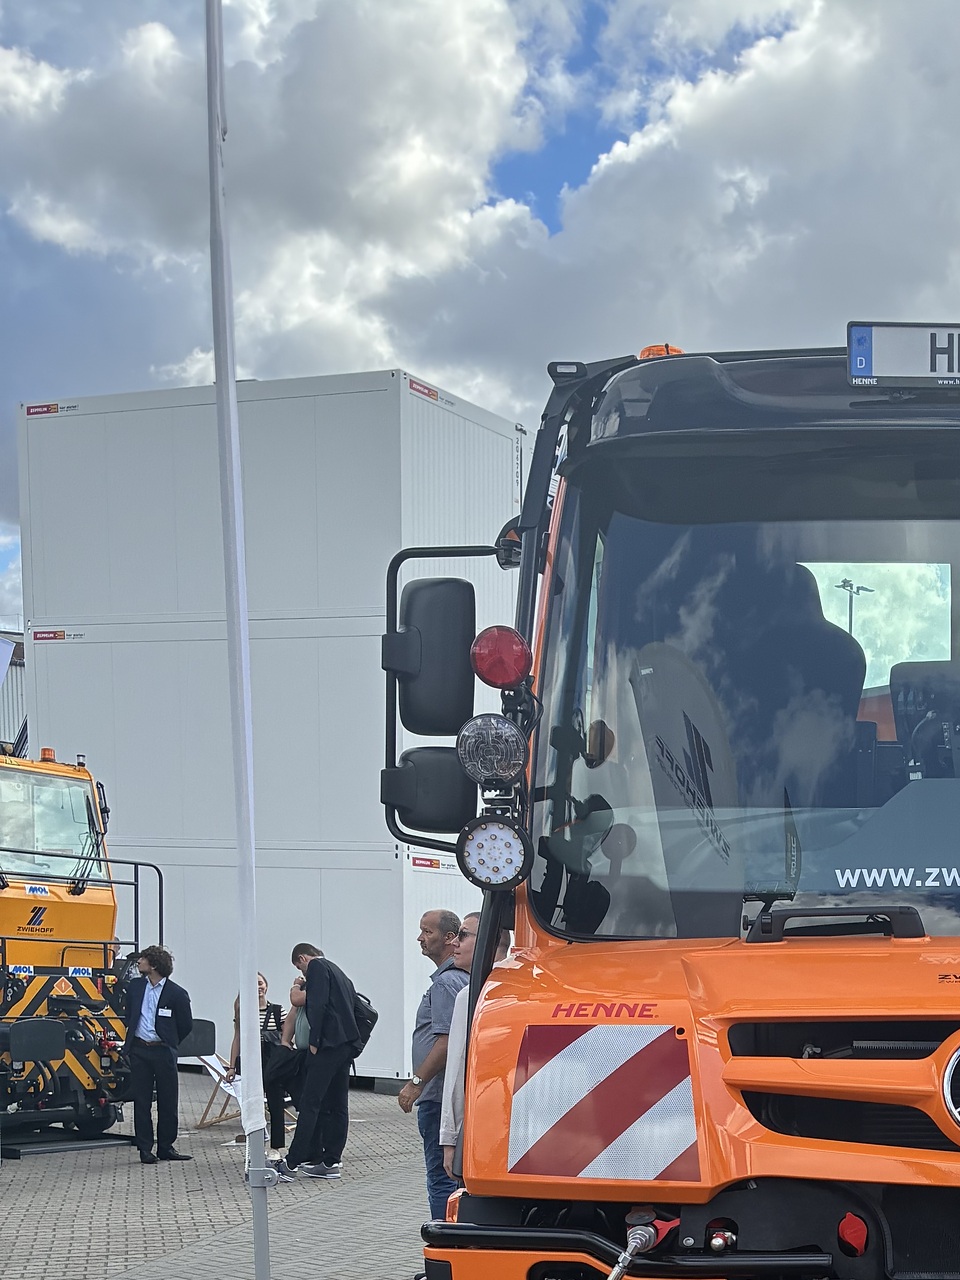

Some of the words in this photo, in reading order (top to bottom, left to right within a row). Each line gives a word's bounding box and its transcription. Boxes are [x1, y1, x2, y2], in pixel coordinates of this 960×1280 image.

[857, 356, 866, 369] D
[852, 378, 878, 386] HENNE
[28, 886, 48, 895] MOL
[12, 966, 33, 975] MOL
[71, 967, 91, 976] MOL
[552, 1003, 658, 1018] HENNE
